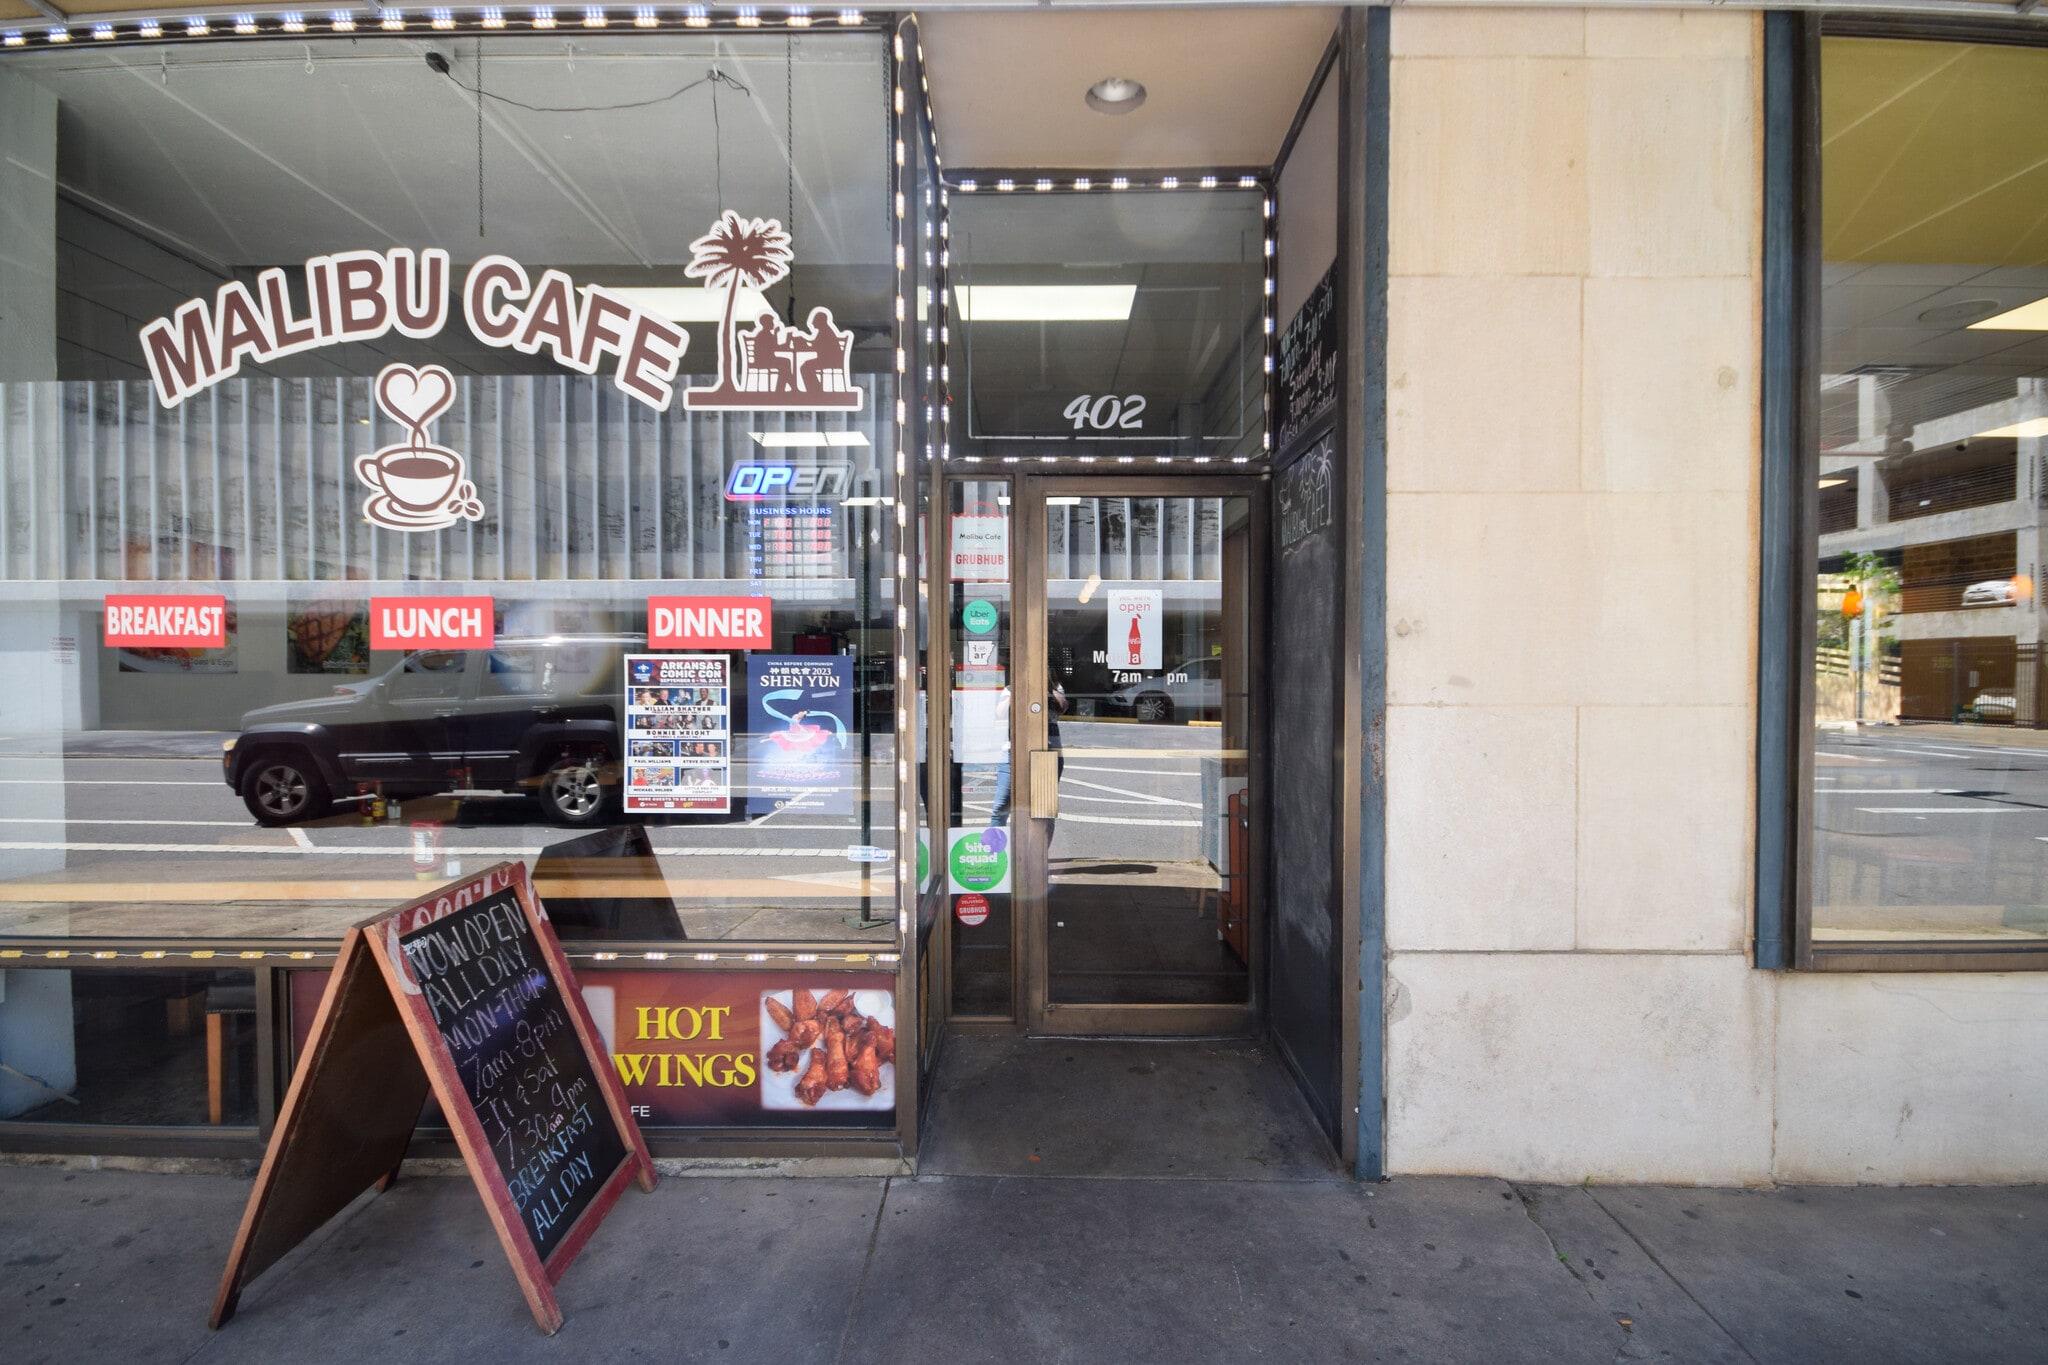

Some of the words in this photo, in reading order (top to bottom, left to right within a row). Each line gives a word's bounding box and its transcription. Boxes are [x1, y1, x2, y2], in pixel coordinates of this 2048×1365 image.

[140, 247, 450, 408] MALIBU
[465, 255, 690, 412] CAFE
[1063, 394, 1147, 430] 402
[733, 467, 847, 494] OPEN
[749, 507, 797, 515] BUSINESS
[799, 507, 832, 515] HOURS
[1305, 484, 1325, 534] CAFE
[749, 567, 763, 575] FRI
[956, 554, 1004, 565] GRUBHUB
[107, 606, 222, 636] BREAKFAST
[970, 610, 989, 618] Uber
[1119, 603, 1151, 613] open
[383, 608, 481, 638] LUNCH
[655, 608, 763, 638] DINNER
[217, 658, 234, 667] Eggs
[660, 670, 696, 678] COMIC
[698, 670, 722, 678] CON
[661, 661, 722, 670] ARKANSAS
[760, 675, 803, 687] SHEN
[807, 675, 840, 687] YUN
[1112, 670, 1142, 683] 7am
[1167, 672, 1188, 685] pm
[959, 852, 998, 865] squad
[965, 842, 991, 852] bite
[404, 926, 470, 982] NOW
[464, 897, 527, 956] OPEN
[424, 971, 485, 1025] ALL
[477, 941, 528, 987] DAY
[635, 1006, 730, 1040] HOT
[525, 1053, 558, 1094] Sat
[612, 1053, 755, 1087] WINGS
[508, 1102, 593, 1213] BREAKFAST
[531, 1187, 569, 1240] ALL
[560, 1151, 593, 1198] DAY
